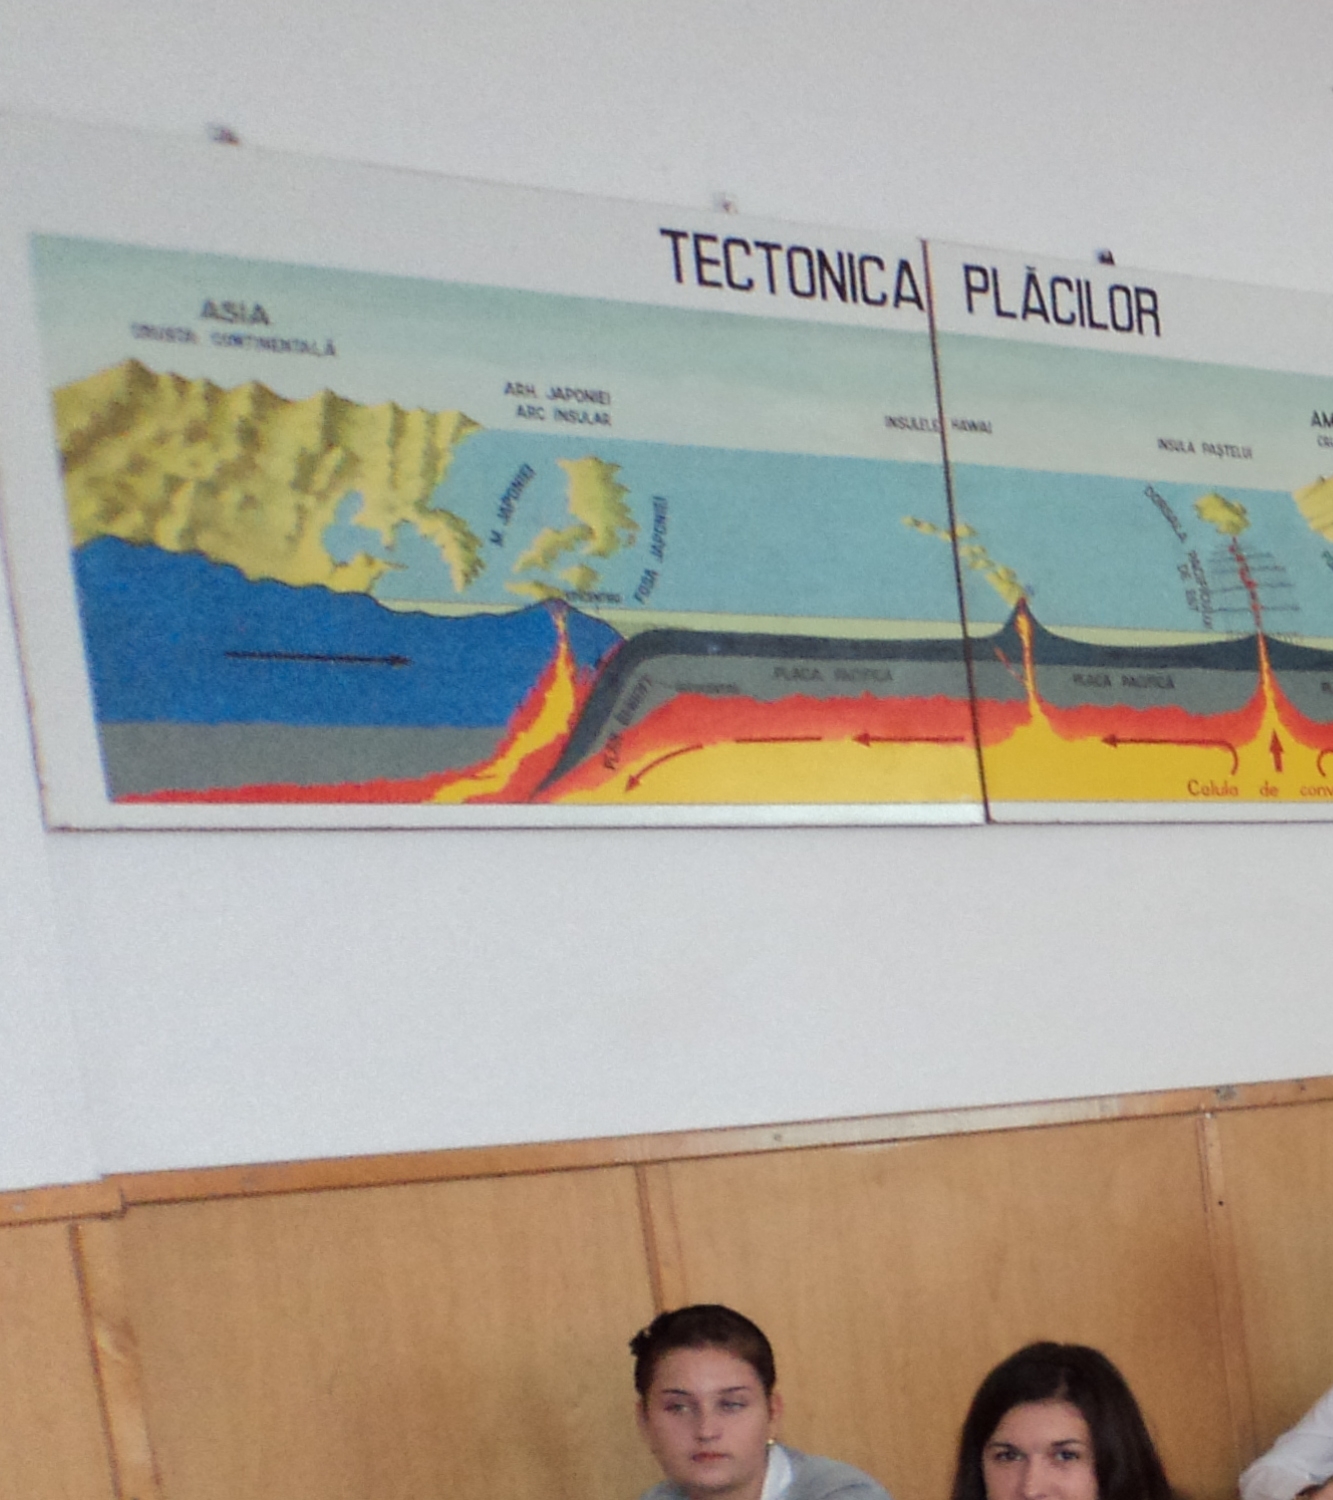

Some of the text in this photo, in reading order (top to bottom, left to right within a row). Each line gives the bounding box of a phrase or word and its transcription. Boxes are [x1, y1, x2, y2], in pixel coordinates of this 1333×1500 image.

[659, 227, 1162, 338] TECTONICA PLĂCILOR
[201, 300, 270, 325] ASIA
[516, 404, 612, 427] ARC INSULAR
[1259, 780, 1280, 797] de
